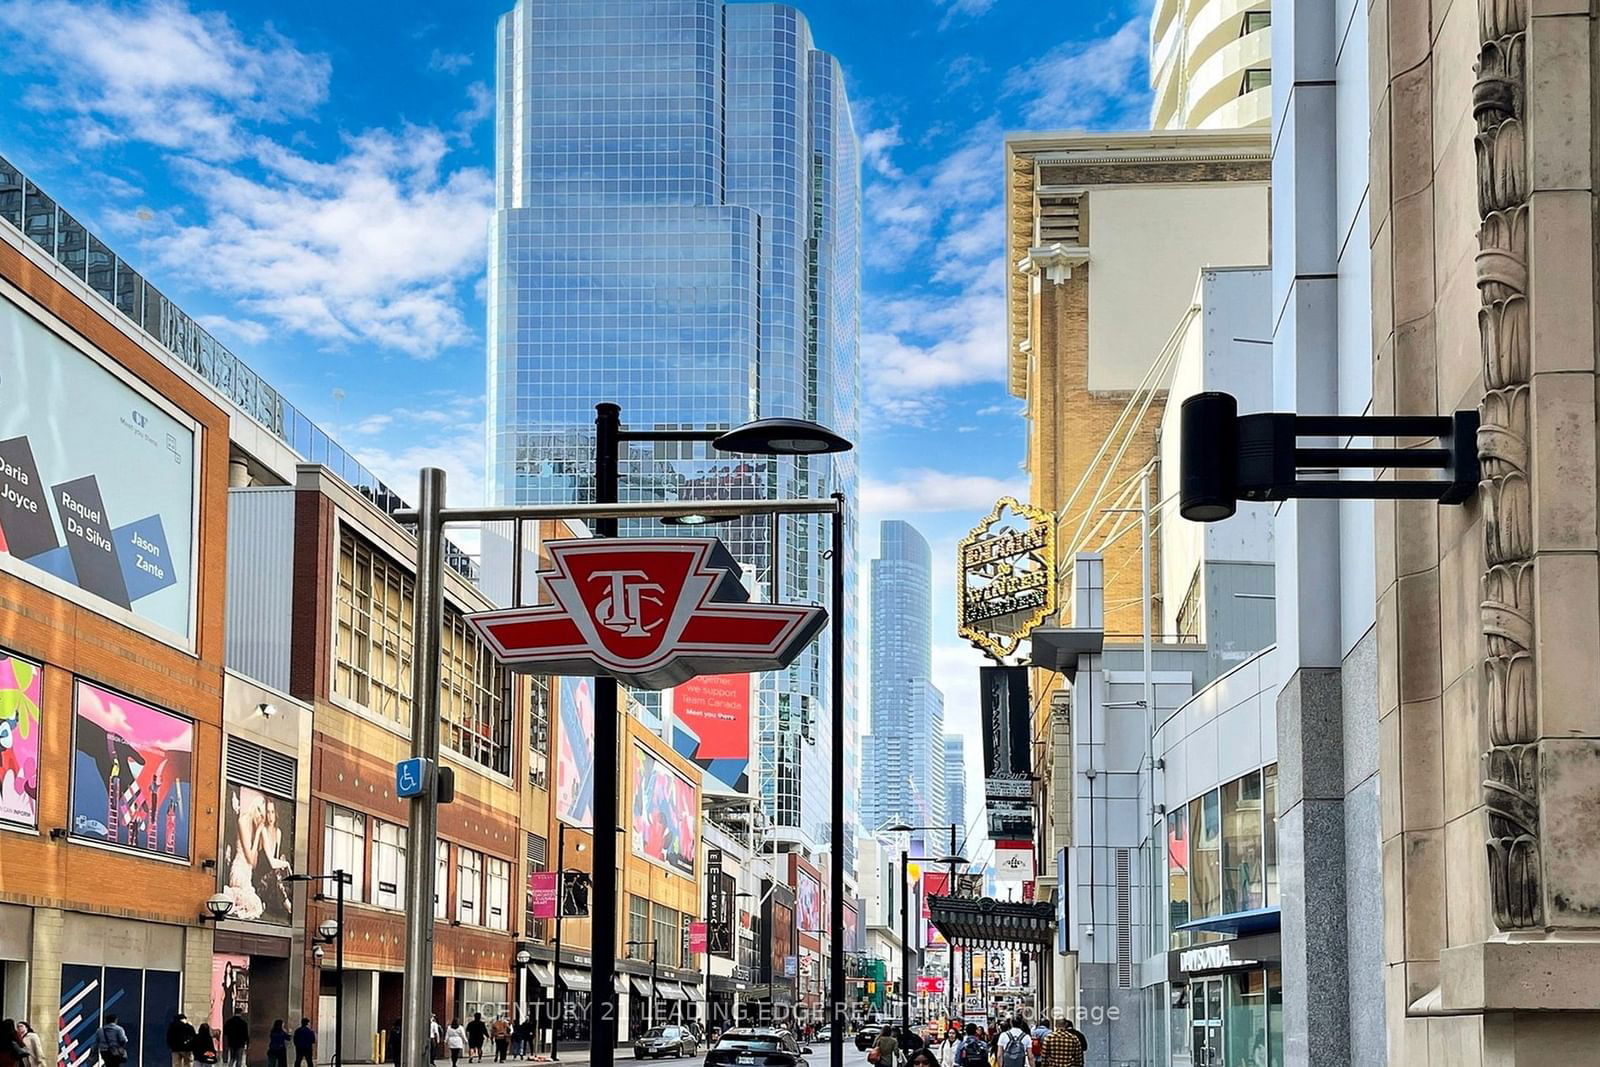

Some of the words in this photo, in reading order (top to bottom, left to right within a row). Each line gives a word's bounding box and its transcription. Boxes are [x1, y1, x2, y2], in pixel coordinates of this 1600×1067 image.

[132, 410, 148, 428] CF
[0, 456, 29, 485] Daria
[1, 484, 37, 513] Joyce
[62, 491, 101, 525] Raquel
[67, 517, 84, 538] Da
[86, 527, 112, 553] Silva
[131, 531, 160, 557] Jason
[136, 554, 165, 580] Zante
[682, 694, 706, 706] Team
[707, 697, 742, 710] Canada
[686, 685, 701, 693] we
[703, 687, 737, 698] support
[685, 709, 704, 717] Meet
[703, 711, 718, 720] you
